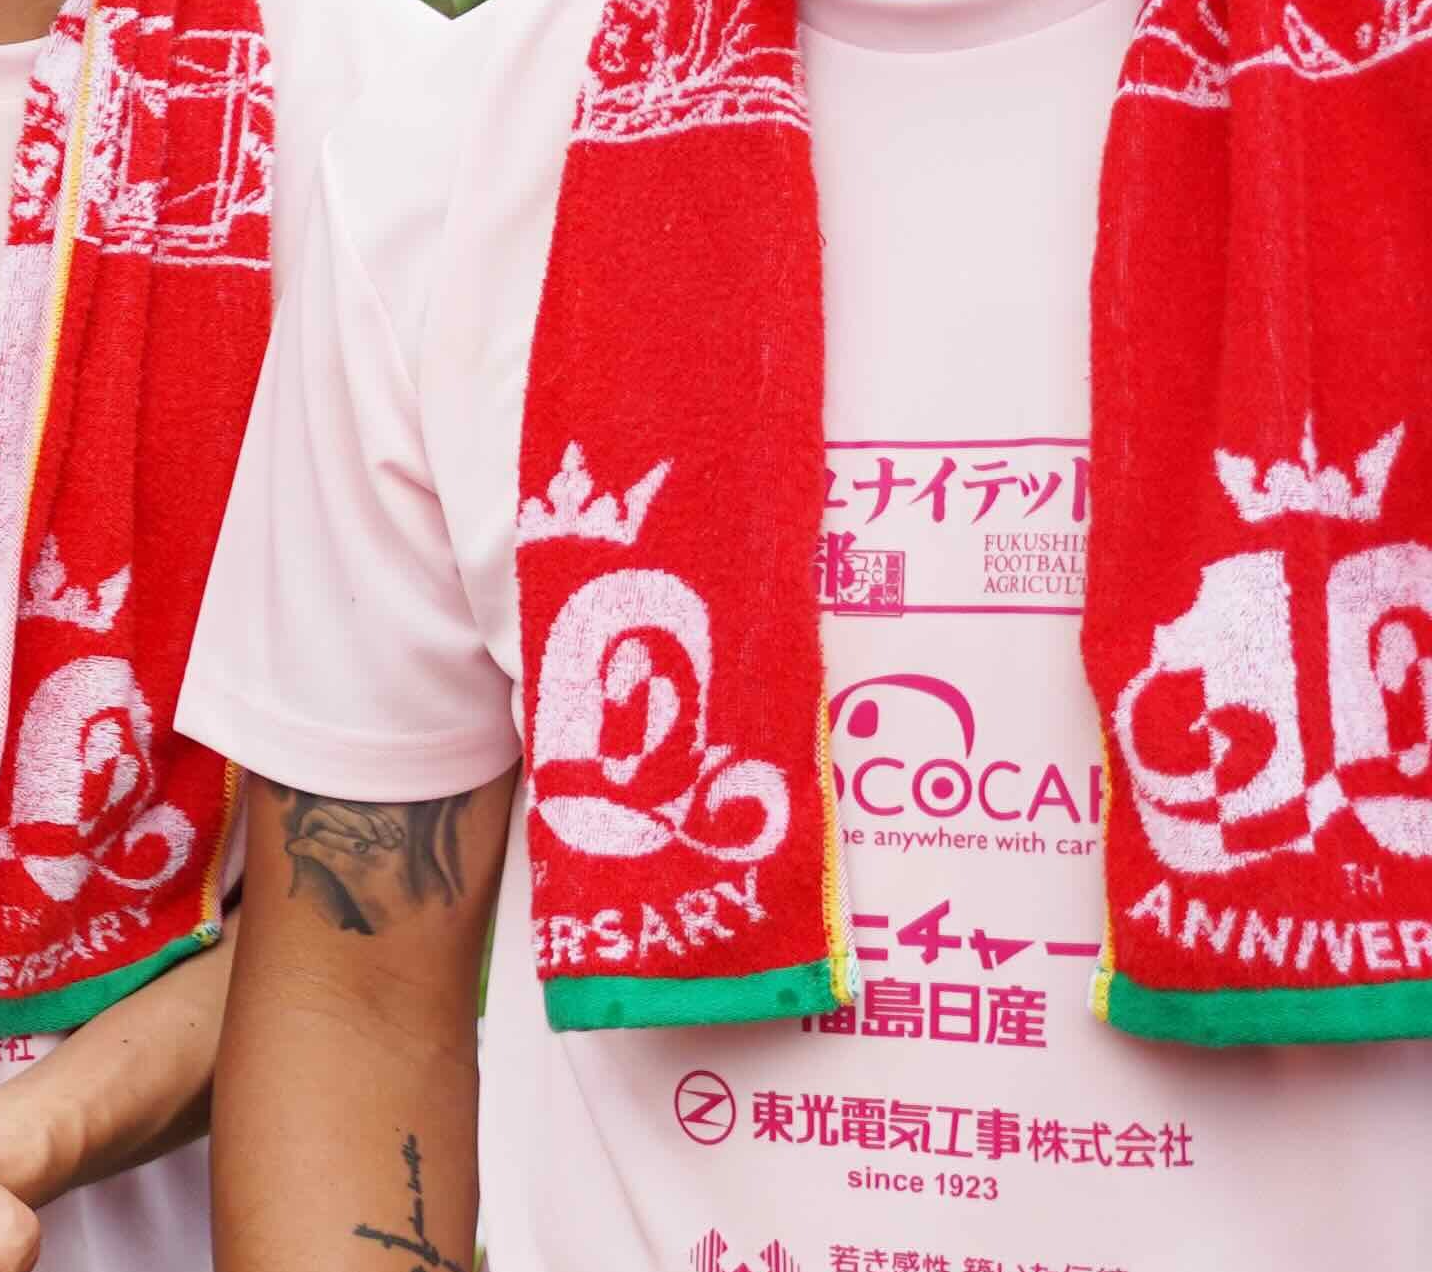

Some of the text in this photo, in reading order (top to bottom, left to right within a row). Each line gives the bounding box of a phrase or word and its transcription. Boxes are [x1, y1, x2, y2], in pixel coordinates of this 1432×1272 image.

[873, 827, 989, 853] anywhere
[995, 830, 1046, 855] with
[1055, 838, 1097, 856] car
[751, 1090, 1195, 1169] 東光電気工事株式会社
[846, 1167, 1000, 1202] since 1923
